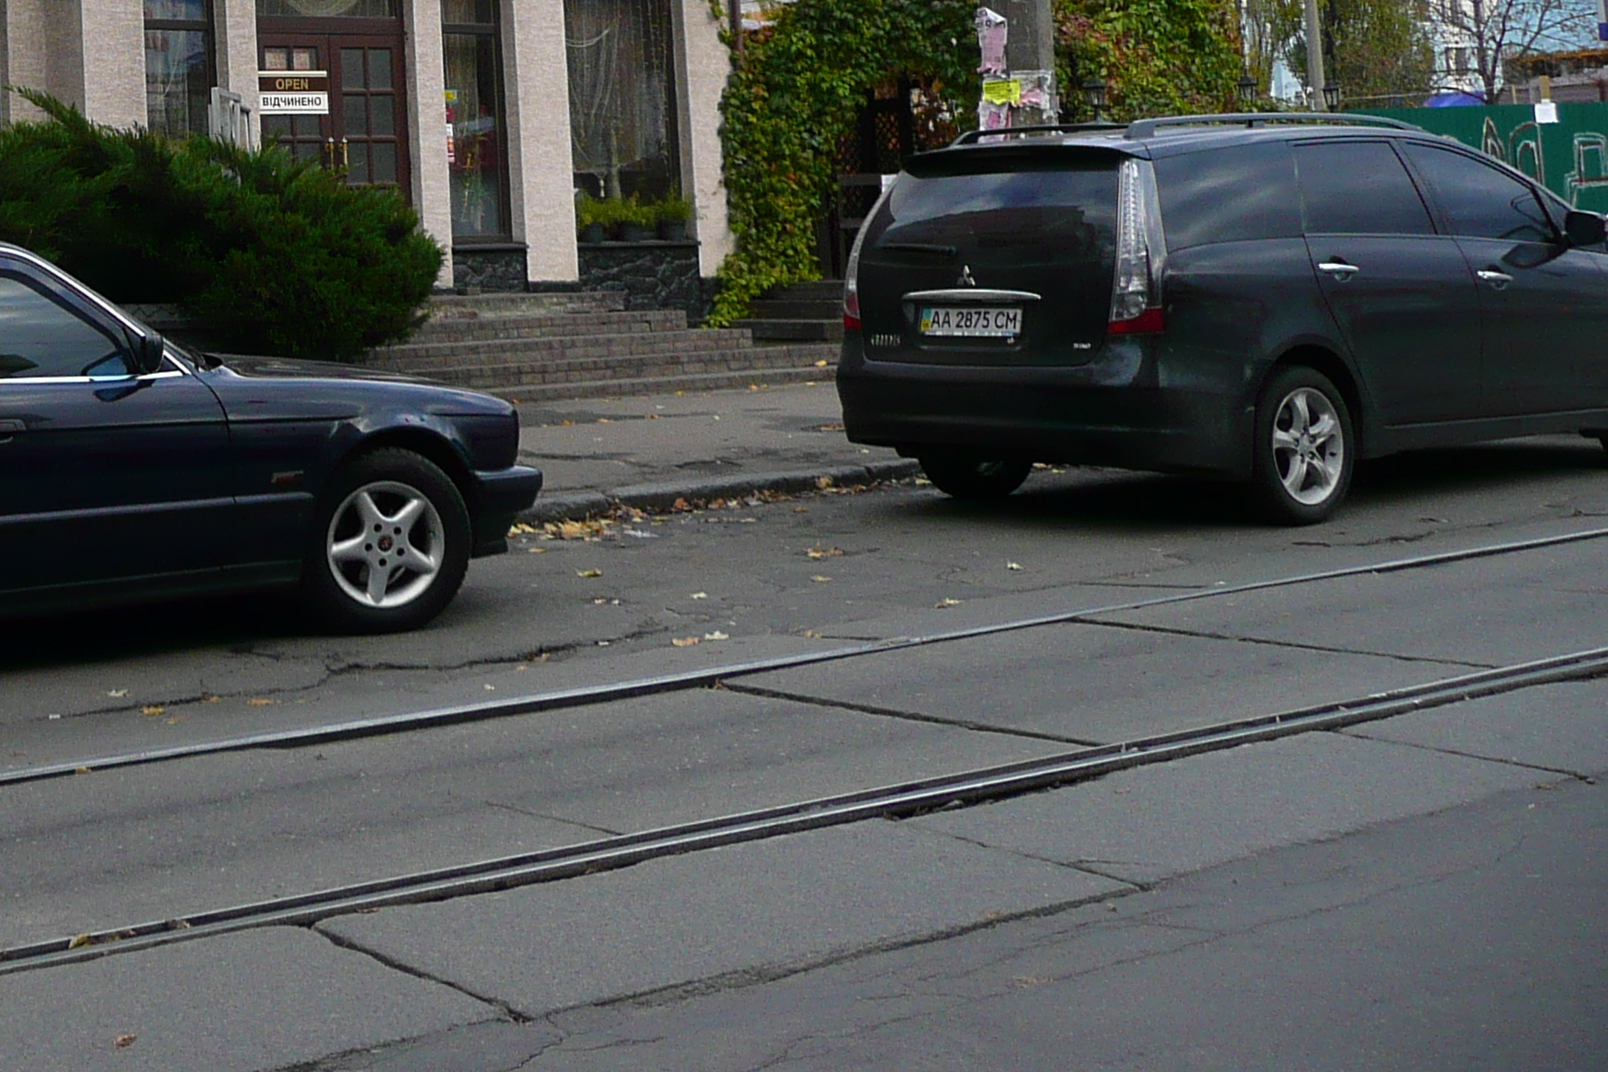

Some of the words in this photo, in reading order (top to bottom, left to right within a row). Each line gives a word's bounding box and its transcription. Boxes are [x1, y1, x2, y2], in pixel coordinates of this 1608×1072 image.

[275, 78, 309, 90] OPEN
[262, 96, 322, 108] ВІДЧИНЕНО
[931, 311, 951, 328] AA
[956, 311, 990, 329] 2875
[995, 311, 1018, 329] CM
